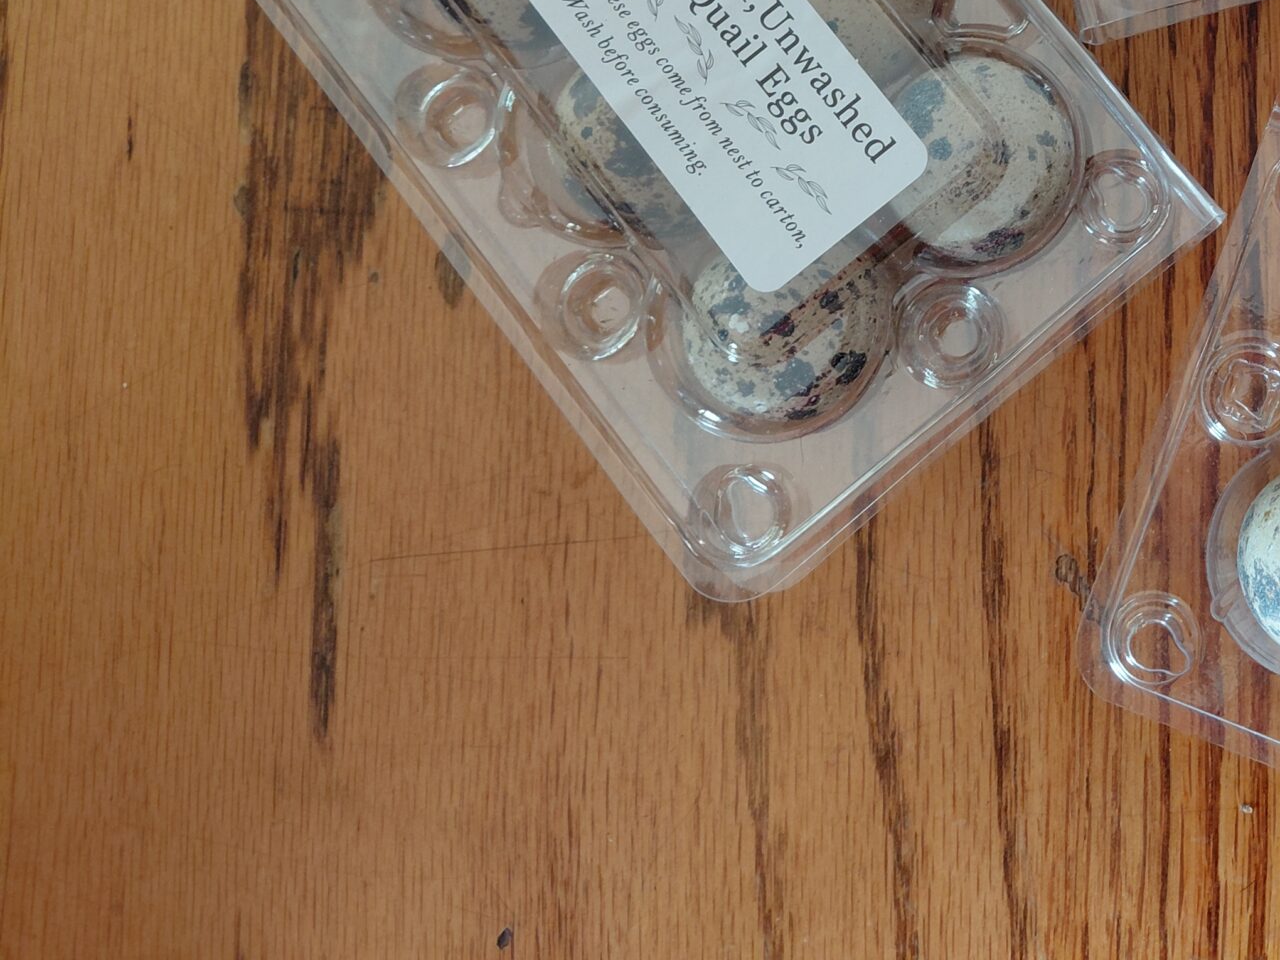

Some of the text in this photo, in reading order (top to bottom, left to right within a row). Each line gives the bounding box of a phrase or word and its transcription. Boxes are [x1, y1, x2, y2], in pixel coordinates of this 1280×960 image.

[596, 34, 640, 87] before
[633, 87, 708, 177] consuming.
[625, 20, 661, 56] eggs
[654, 56, 693, 97] come
[678, 95, 724, 137] from
[717, 135, 754, 171] nest
[744, 168, 764, 188] to
[759, 189, 807, 250] carton,
[754, 61, 824, 145] Eggs
